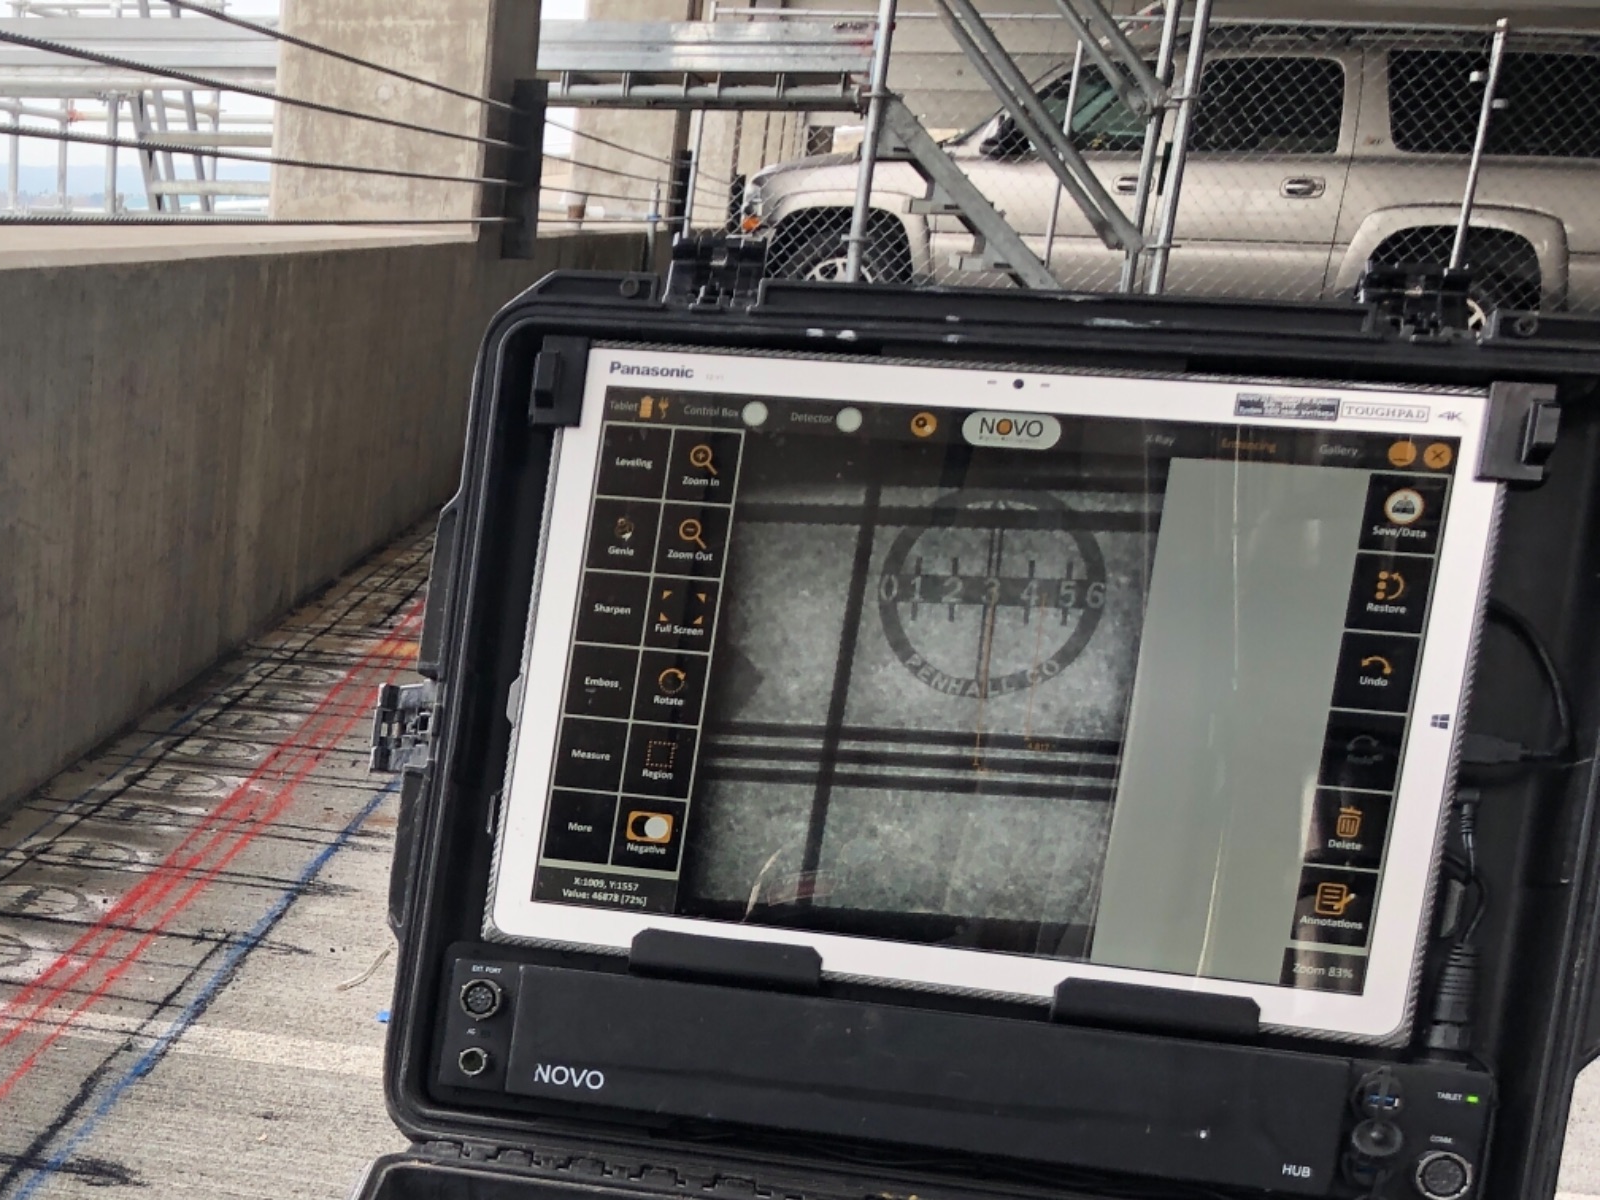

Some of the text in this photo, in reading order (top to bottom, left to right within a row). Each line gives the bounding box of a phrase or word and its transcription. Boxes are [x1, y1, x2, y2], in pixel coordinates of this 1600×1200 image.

[610, 361, 694, 378] Panasonic
[610, 401, 638, 411] Tablet
[684, 405, 740, 418] Control Box
[791, 412, 834, 424] Detector
[1345, 405, 1427, 420] TOUGHPAD
[980, 417, 1044, 438] NOVO
[1319, 444, 1359, 457] Gallery
[615, 457, 653, 469] Leveling
[682, 476, 708, 486] Zoom
[1372, 525, 1428, 539] Save/Data
[667, 549, 713, 561] Zoom Out
[942, 576, 964, 603] 2
[1020, 580, 1040, 607] 4
[1059, 580, 1077, 607] 5
[594, 603, 631, 615] Sharpen
[1366, 603, 1407, 614] Restore
[655, 624, 704, 636] Full Screen
[1359, 676, 1388, 687] Undo
[654, 695, 684, 706] Rotate
[571, 749, 611, 761] Measure
[642, 769, 673, 780] Region
[568, 822, 593, 833] More
[626, 842, 666, 855] Negative
[1328, 839, 1362, 851] Delete
[562, 888, 589, 899] Value:
[1300, 915, 1364, 930] Annotations
[1292, 963, 1324, 976] Zoom
[533, 1063, 605, 1090] NOVO
[1436, 1091, 1463, 1101] TABLET
[1281, 1163, 1311, 1178] HUB
